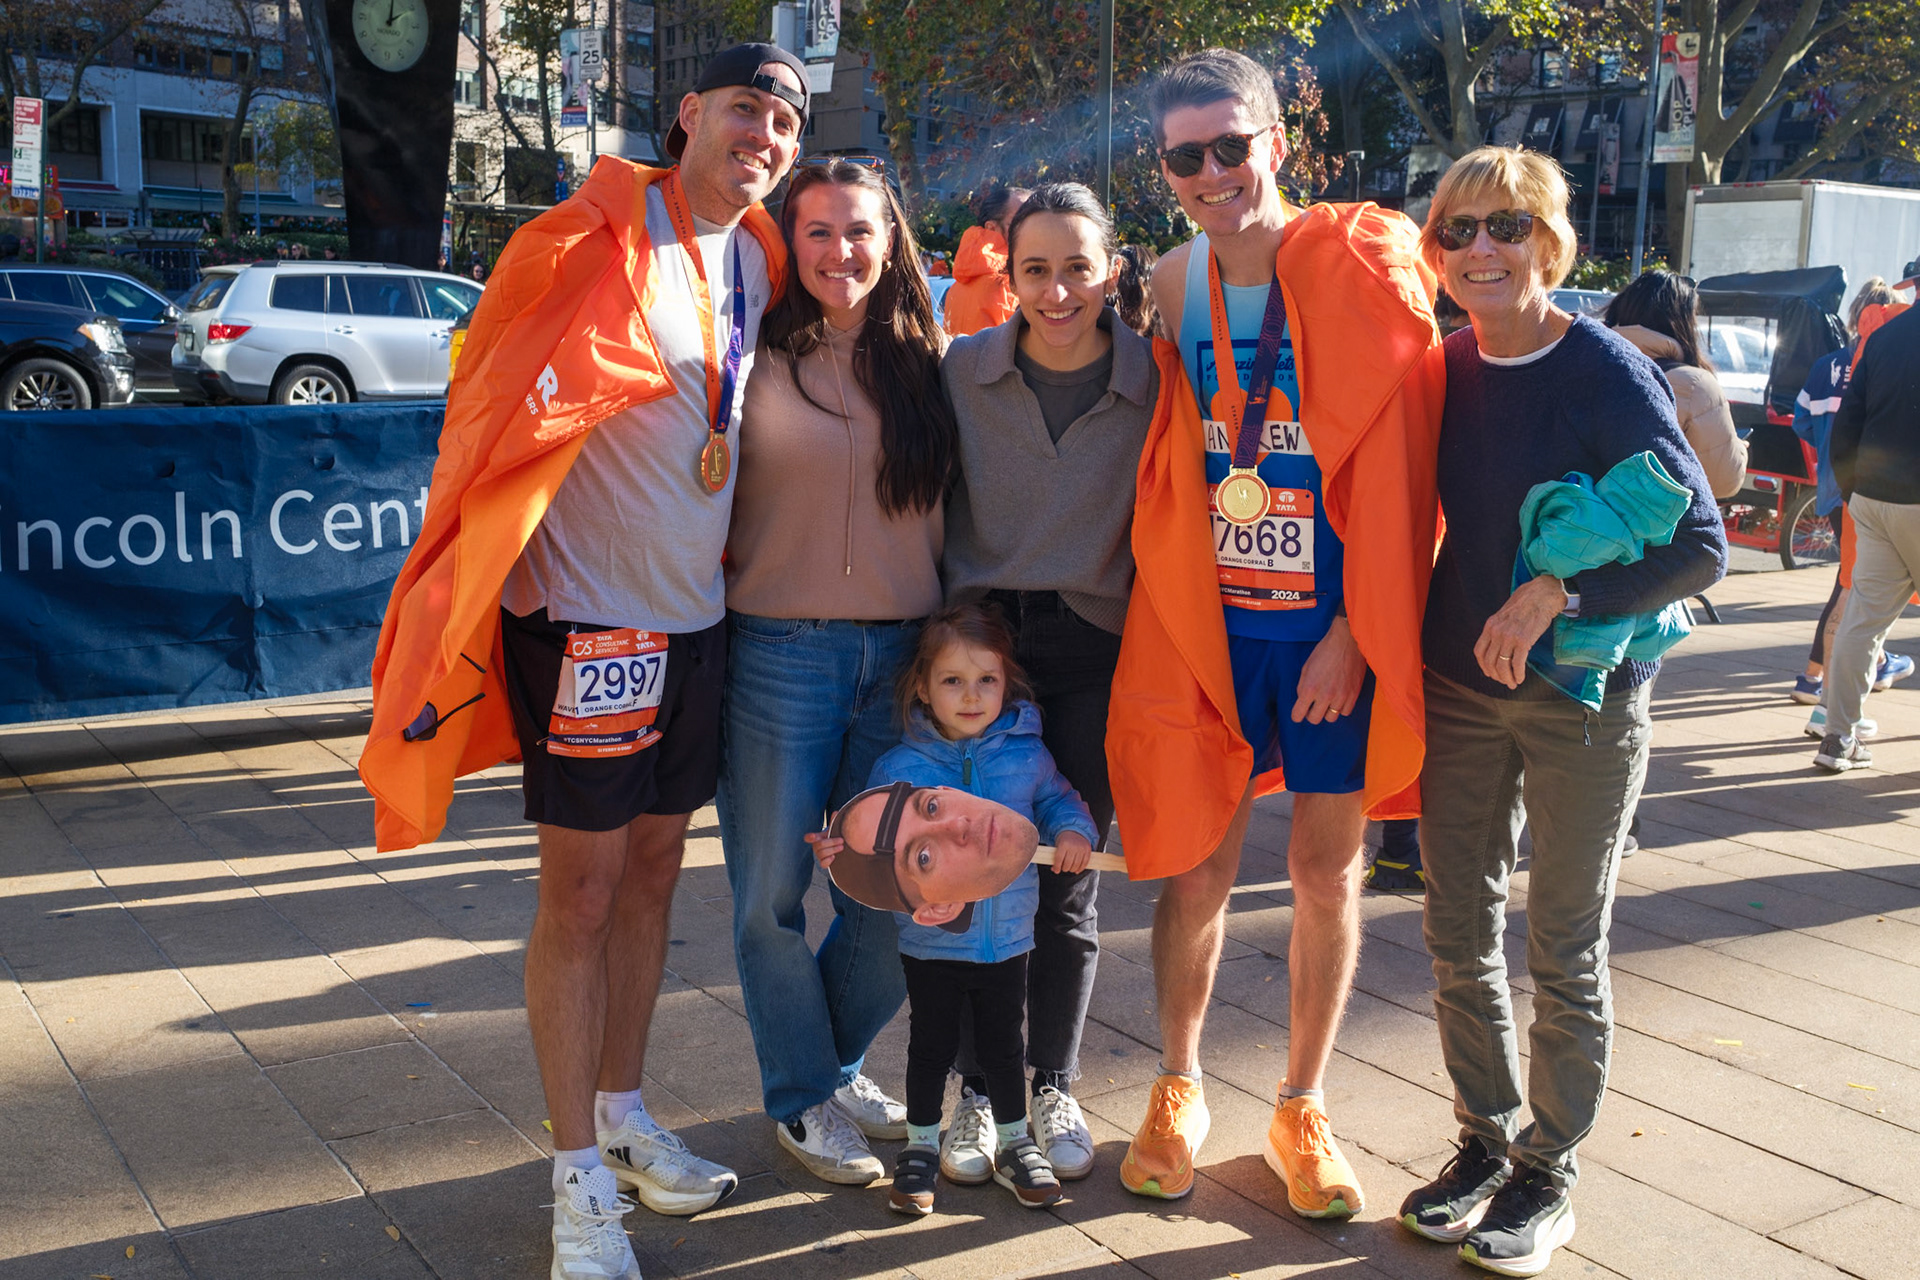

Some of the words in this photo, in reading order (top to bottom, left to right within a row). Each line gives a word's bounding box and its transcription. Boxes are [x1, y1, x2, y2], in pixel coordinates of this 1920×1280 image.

[582, 50, 600, 64] 25
[1670, 100, 1683, 143] SHOP
[1208, 423, 1300, 452] ANEW
[1275, 504, 1297, 512] TATA
[0, 491, 243, 572] ncoln
[1220, 555, 1243, 564] ORANGE
[1243, 557, 1266, 566] CORRAL
[1267, 559, 1274, 567] B
[1271, 590, 1301, 601] 2024
[594, 646, 619, 654] SERVICES
[635, 641, 656, 650] TATA
[580, 656, 661, 703] 2997
[584, 704, 613, 713] ORANGE
[632, 698, 638, 708] F
